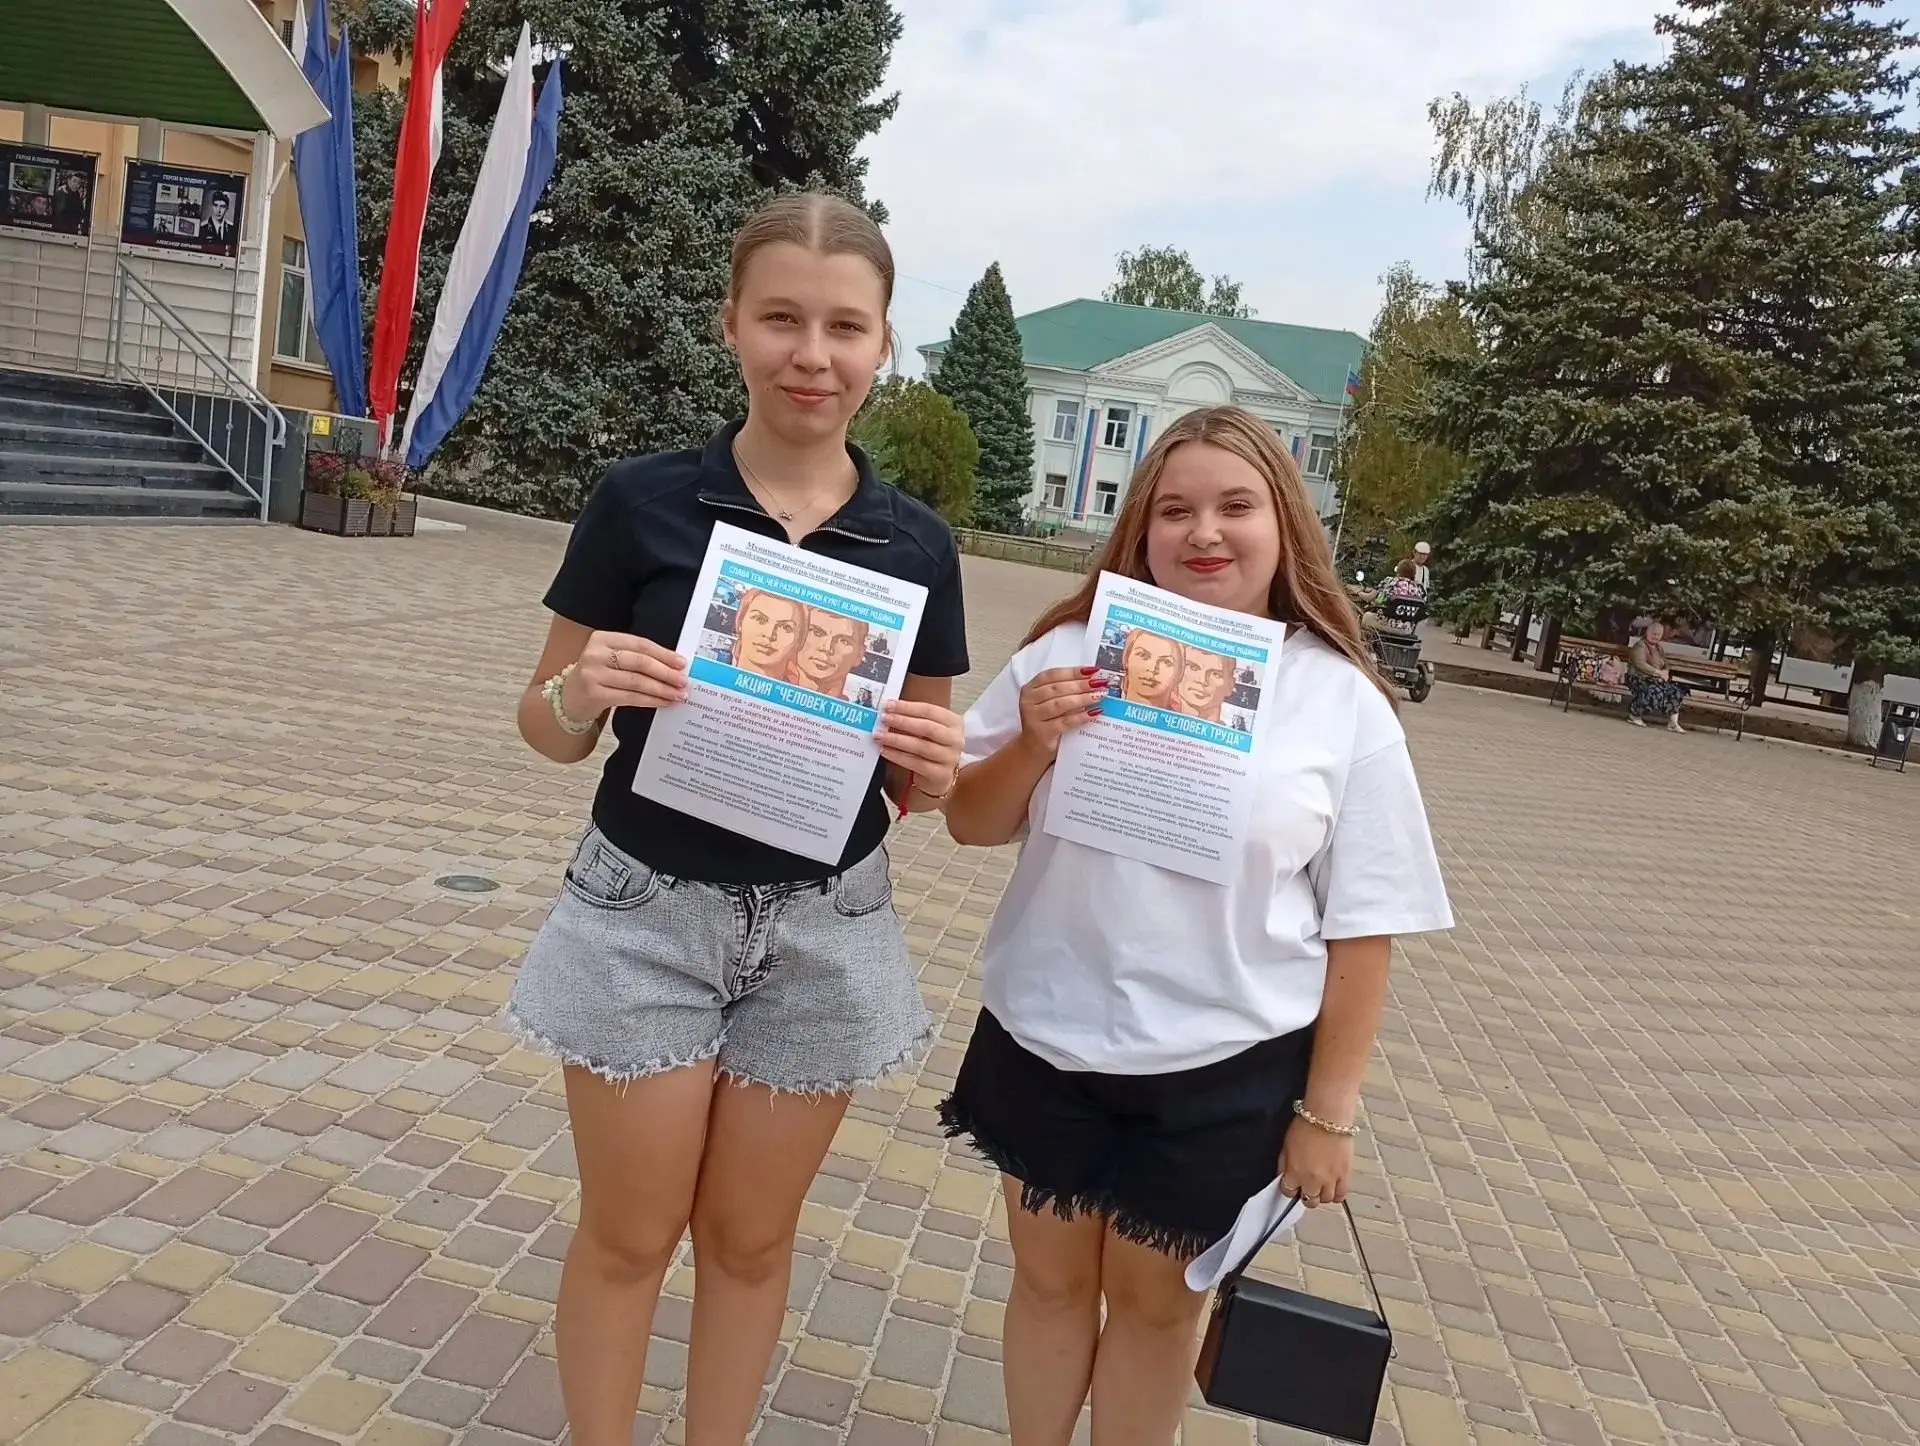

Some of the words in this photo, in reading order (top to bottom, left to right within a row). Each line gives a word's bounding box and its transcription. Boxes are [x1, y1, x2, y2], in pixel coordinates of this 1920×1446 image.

[727, 564, 750, 579] СЛАВА
[765, 576, 781, 589] ЧЕЙ
[779, 581, 801, 595] РАЗУМ
[806, 589, 823, 602] РУКИ
[840, 600, 870, 616] ВЕЛИЧИЕ
[870, 609, 897, 624] РОДИНЫ
[734, 672, 773, 696] АКЦИЯ
[693, 683, 718, 697] Люди
[718, 693, 742, 705] труда
[762, 706, 790, 718] основа
[790, 713, 821, 727] любого
[729, 705, 743, 713] его
[743, 709, 771, 722] костяк
[1124, 704, 1158, 723] АКЦИЯ
[723, 719, 777, 740] стабильность
[788, 731, 802, 739] его
